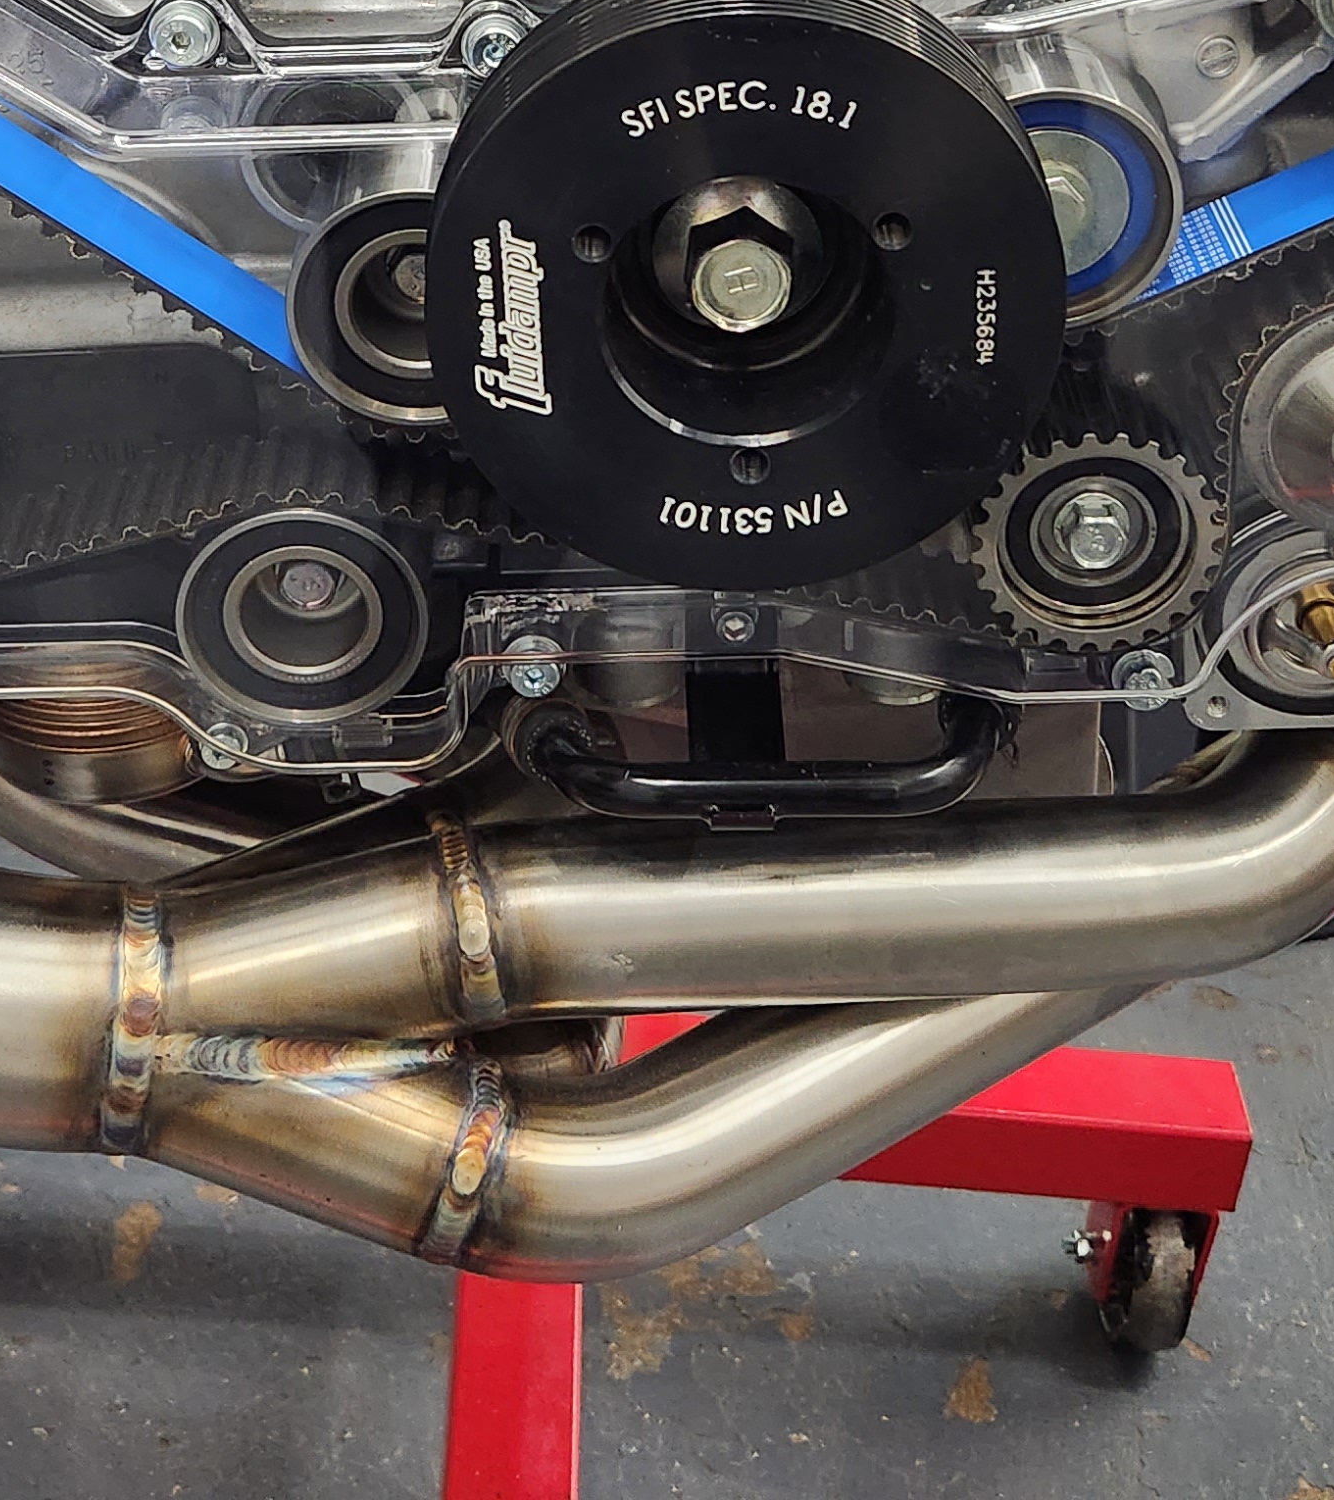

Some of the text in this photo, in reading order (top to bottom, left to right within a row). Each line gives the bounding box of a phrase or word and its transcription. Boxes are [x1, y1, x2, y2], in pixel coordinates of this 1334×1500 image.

[621, 80, 858, 138] SFI SPEC. 18.1
[473, 237, 492, 271] USA
[477, 274, 494, 301] the
[480, 318, 497, 359] Made
[975, 268, 997, 366] H235684
[659, 489, 849, 536] P/N 531101
